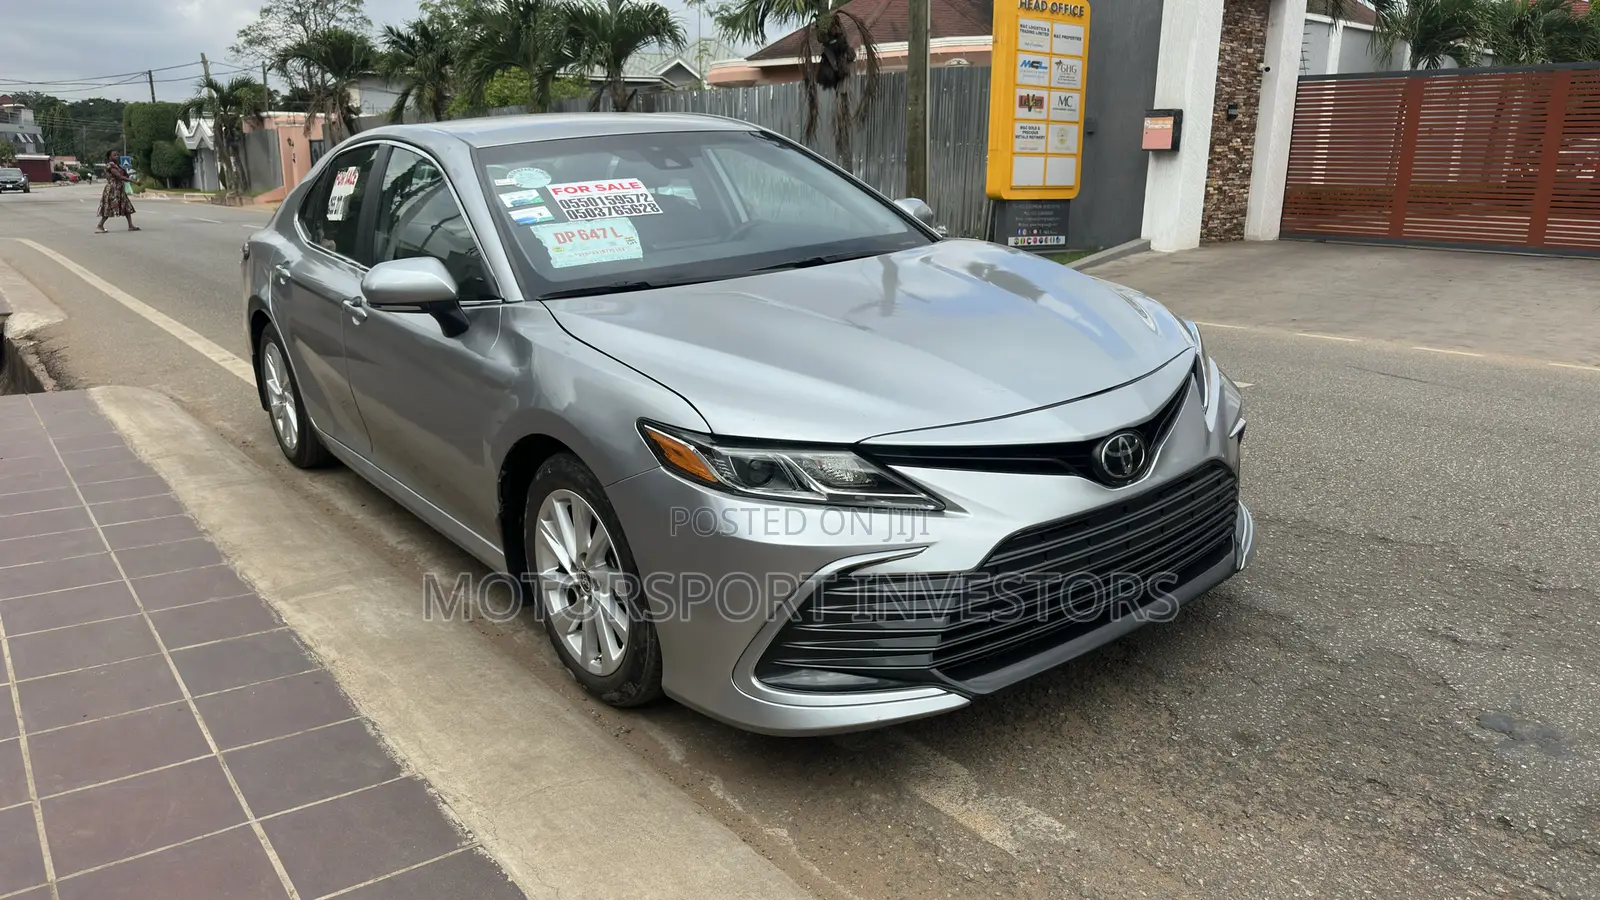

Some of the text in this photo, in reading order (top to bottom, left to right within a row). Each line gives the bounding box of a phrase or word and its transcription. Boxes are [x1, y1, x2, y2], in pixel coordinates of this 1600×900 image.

[1019, 0, 1084, 17] HEAD OFFICE
[552, 182, 642, 196] FOR SALE
[559, 193, 653, 209] 0550159572
[567, 203, 660, 220] 0503765628
[553, 226, 623, 245] DP 647 L
